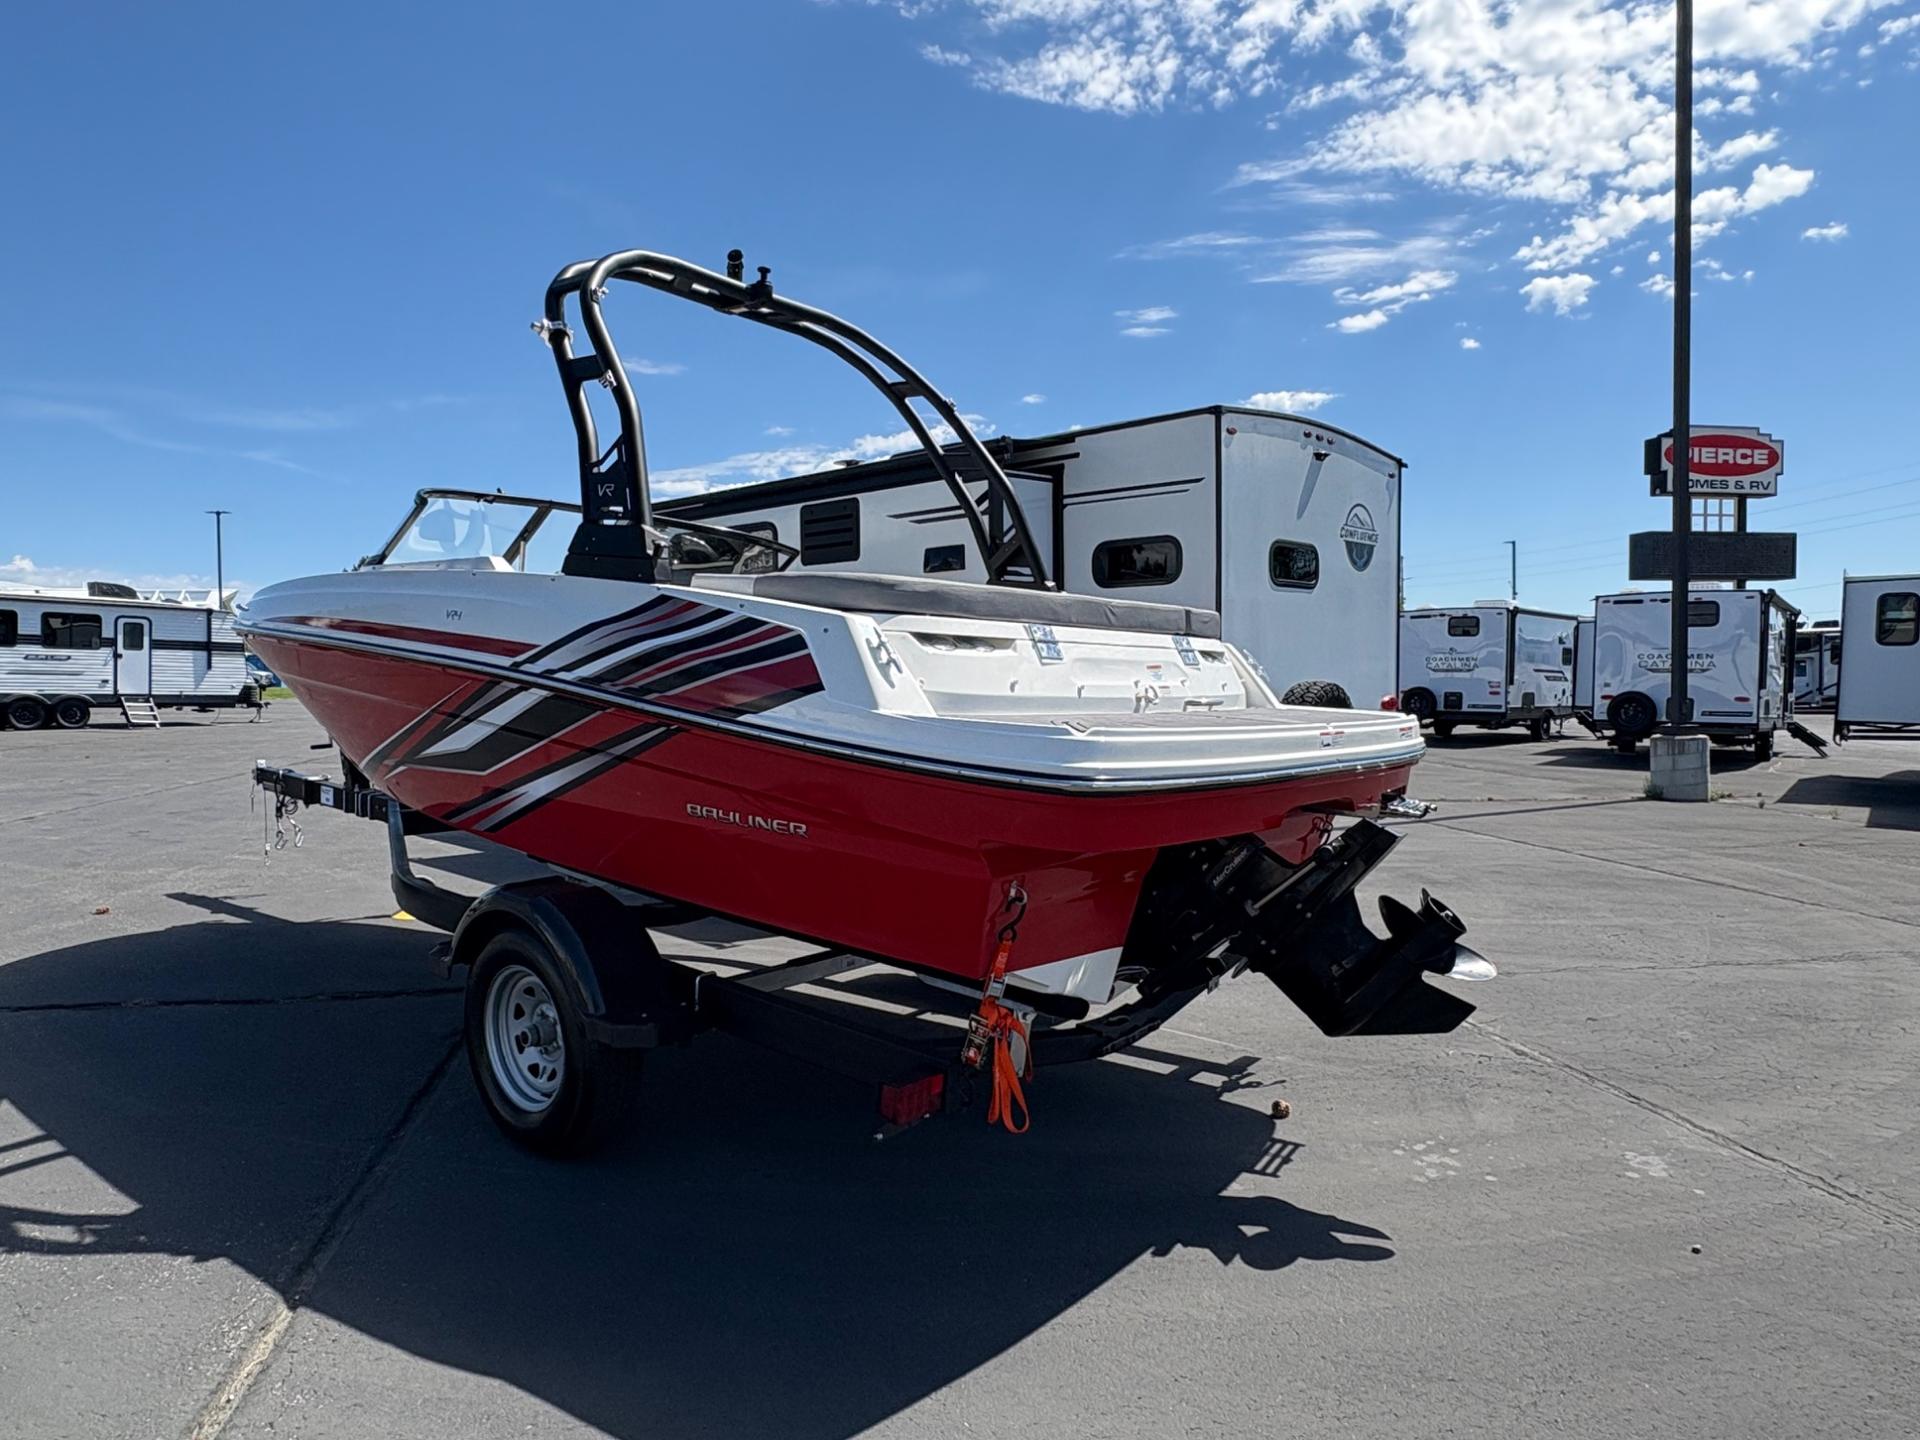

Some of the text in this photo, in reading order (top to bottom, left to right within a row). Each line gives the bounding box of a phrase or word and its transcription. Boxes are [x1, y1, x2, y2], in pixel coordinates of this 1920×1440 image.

[1688, 447, 1769, 465] IERCE
[597, 483, 615, 497] VR
[1688, 479, 1772, 491] OMES & RV
[1340, 526, 1379, 544] CONFLUENCE
[1425, 662, 1480, 670] CATALINA
[1638, 661, 1717, 669] CATINA
[686, 803, 809, 839] BAYLINER
